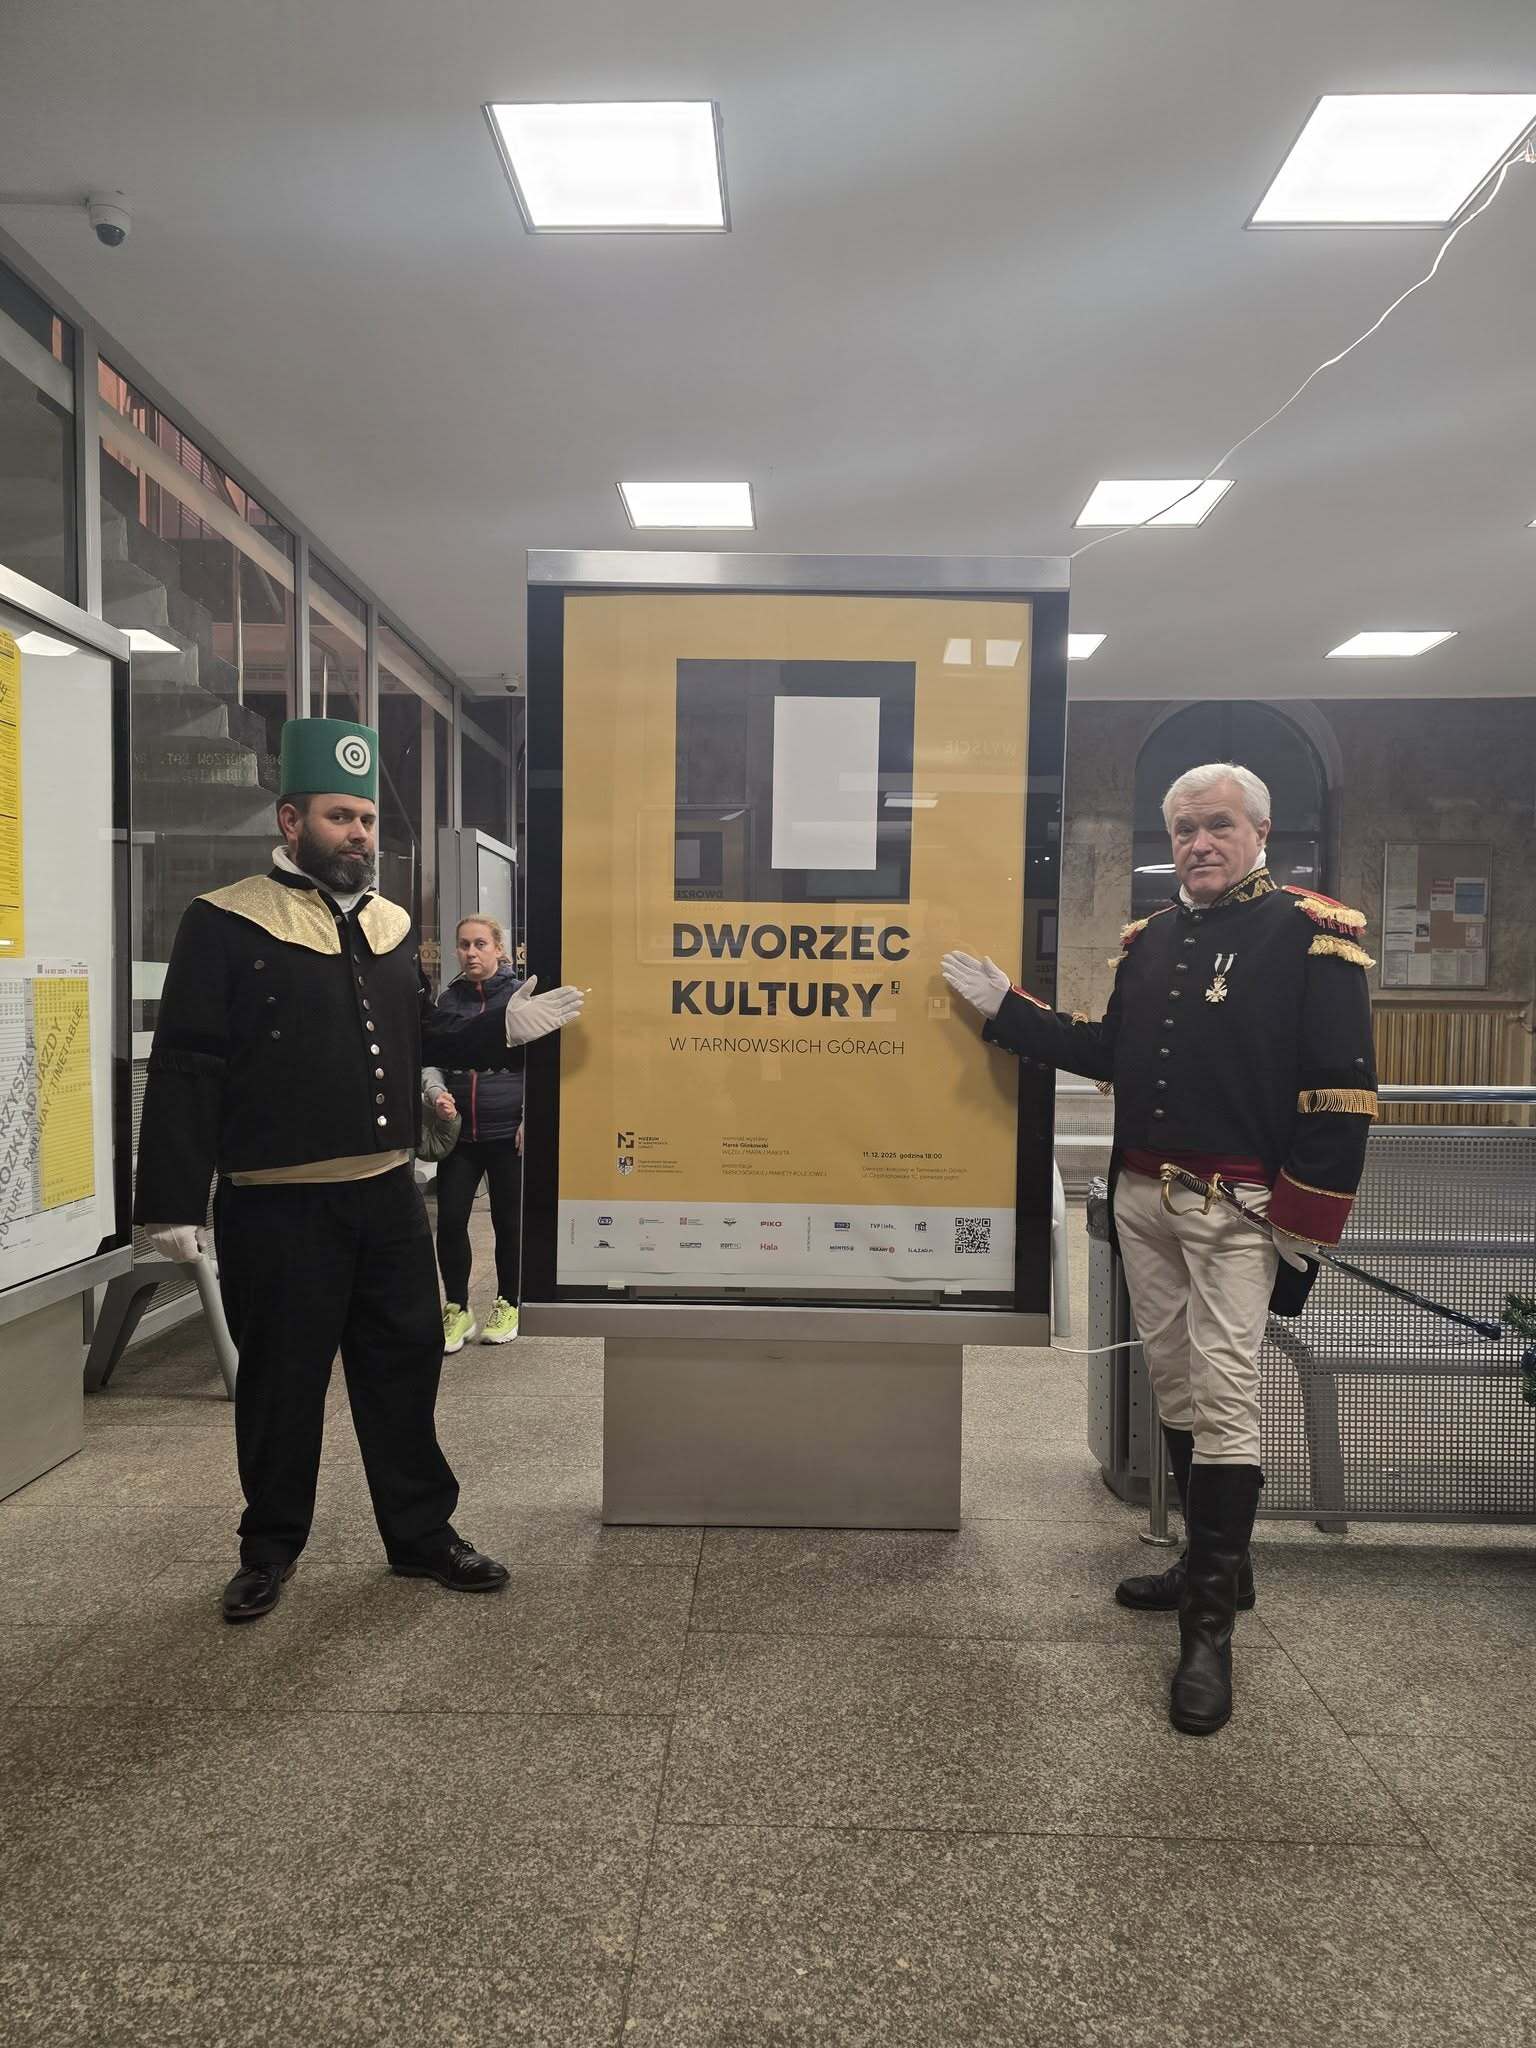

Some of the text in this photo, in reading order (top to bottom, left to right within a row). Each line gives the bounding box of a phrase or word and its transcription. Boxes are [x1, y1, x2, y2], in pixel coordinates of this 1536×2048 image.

[673, 923, 911, 961] DWORZEC
[671, 980, 884, 1017] KULTURY
[49, 1004, 83, 1089] TIMETABLE
[669, 1037, 904, 1055] W TARNOWSKICH GÓRACH
[899, 1152, 924, 1160] godzina
[760, 1243, 778, 1251] Hala
